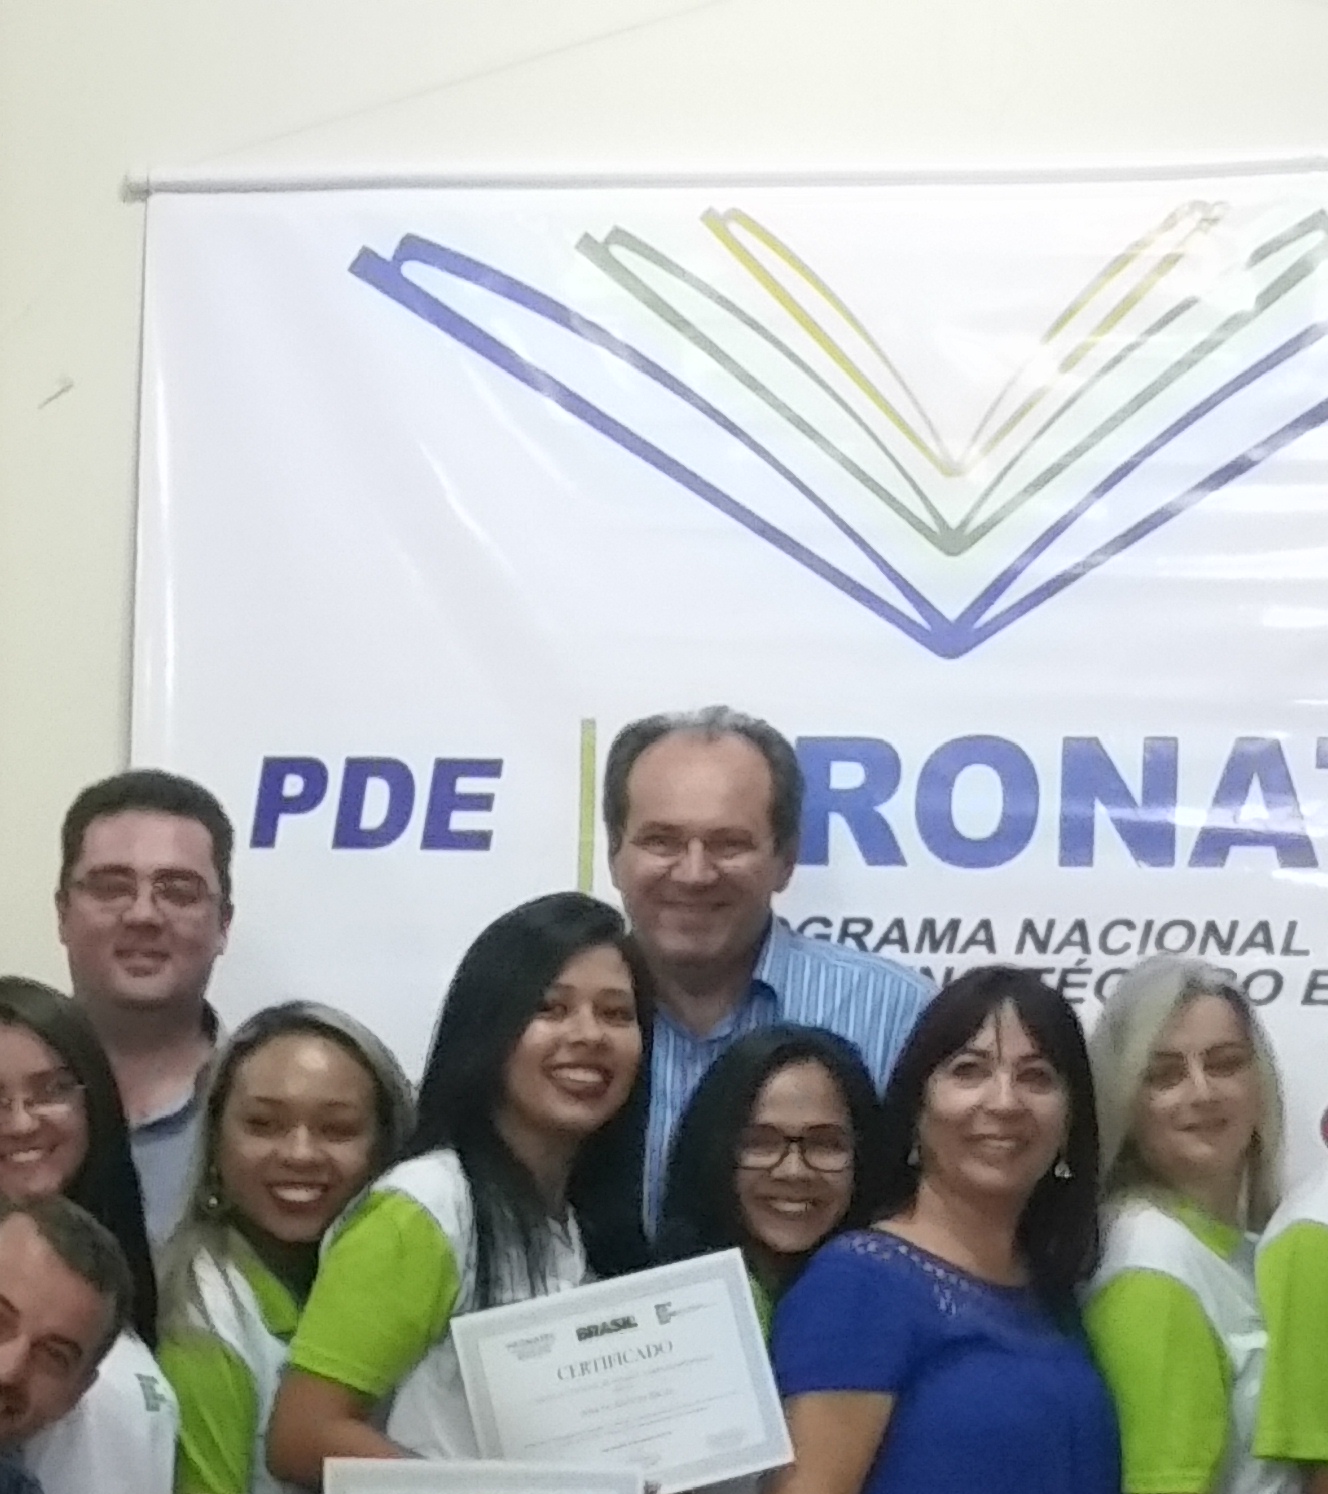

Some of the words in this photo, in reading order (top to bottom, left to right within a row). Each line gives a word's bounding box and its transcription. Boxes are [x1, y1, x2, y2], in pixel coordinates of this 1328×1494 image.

[250, 756, 503, 850] PDE
[1014, 918, 1311, 956] NACIONAL
[556, 1340, 674, 1381] CERTIFICADO
